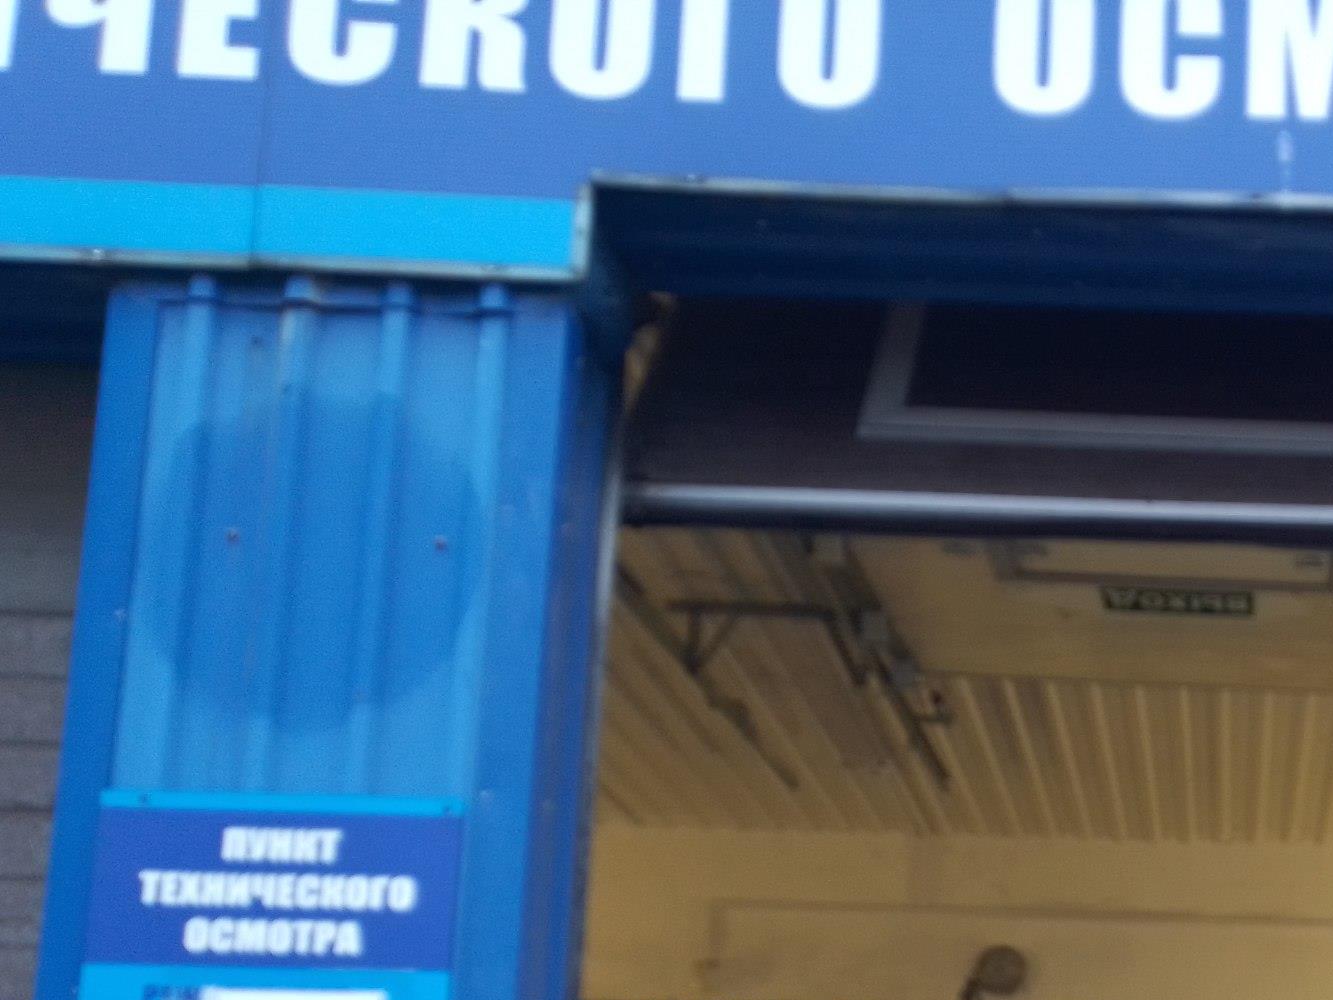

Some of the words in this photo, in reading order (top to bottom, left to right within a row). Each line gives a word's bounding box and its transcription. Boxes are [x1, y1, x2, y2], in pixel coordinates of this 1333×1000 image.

[0, 0, 881, 109] ЧЕСКОГО
[220, 826, 343, 864] ПУНКТ
[138, 869, 417, 913] ТЕХНИЧЕСКОГО
[183, 917, 363, 957] ОСМОТРА
